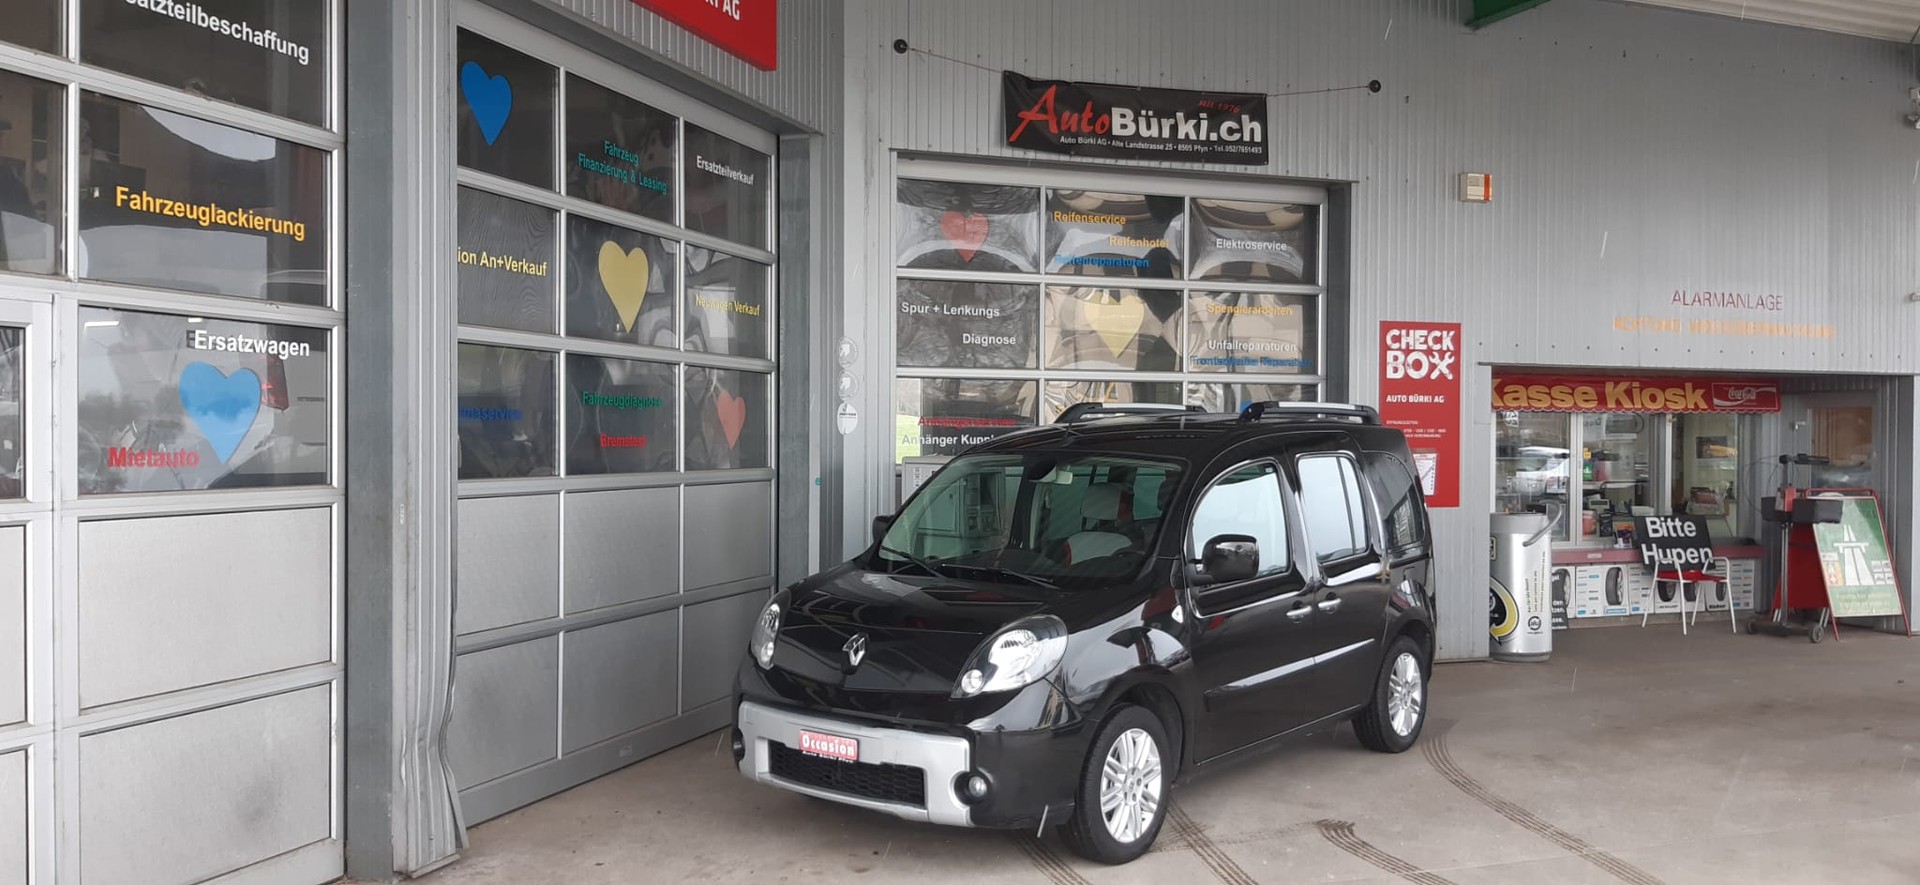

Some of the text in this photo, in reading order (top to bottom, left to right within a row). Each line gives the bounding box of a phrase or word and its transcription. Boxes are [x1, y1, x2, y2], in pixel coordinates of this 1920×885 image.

[1060, 136, 1076, 144] Auto
[604, 140, 639, 166] Fahrzeug
[578, 152, 667, 196] Finanzierung & Leasing
[696, 155, 754, 186] Ersatzteilverkauf
[115, 186, 305, 241] Fahrzeuglackierung
[1053, 211, 1127, 225] Reifenservice
[1216, 238, 1287, 251] Elektroservice
[901, 302, 929, 316] Spur
[944, 305, 1000, 319] Lenkungs
[1672, 290, 1783, 311] ALARMANLAGE
[194, 330, 310, 360] Ersatzwagen
[962, 333, 1016, 345] Diagnose
[1208, 340, 1298, 352] Unfallreparaturen
[1386, 329, 1455, 351] CHECK
[1386, 393, 1445, 404] AUTO BÜRKI AG
[1605, 381, 1708, 409] Kiosk
[902, 433, 957, 447] Anhänger
[109, 447, 199, 467] Mietauto
[1645, 517, 1697, 538] Bitte
[1641, 543, 1714, 568] Hupen
[802, 735, 854, 756] Occasion
